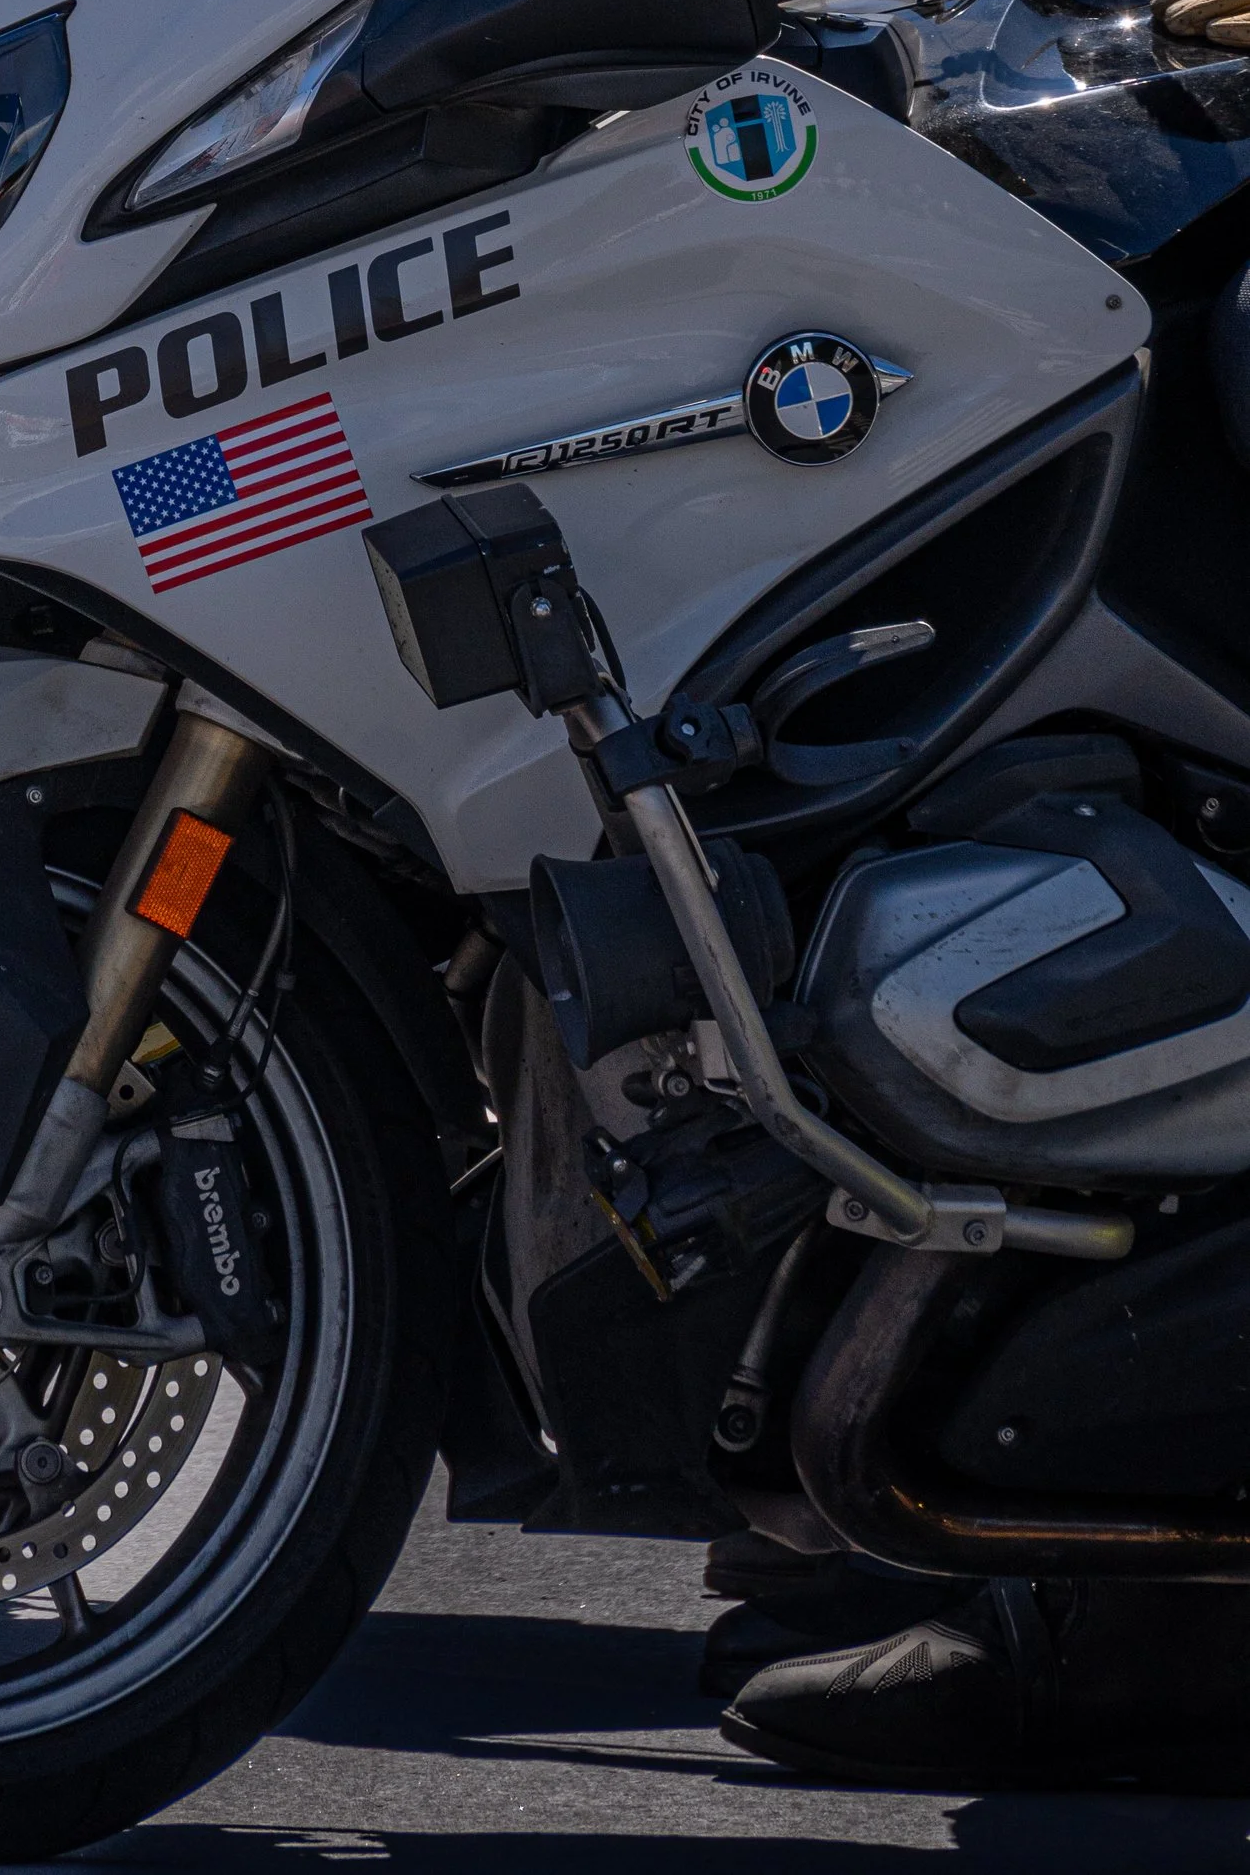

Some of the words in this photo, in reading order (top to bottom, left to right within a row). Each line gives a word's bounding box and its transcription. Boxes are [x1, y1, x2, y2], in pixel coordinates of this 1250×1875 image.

[688, 90, 711, 136] CITY
[716, 72, 743, 91] OF
[751, 71, 811, 116] IRVINE
[751, 188, 777, 201] 1971
[66, 210, 520, 458] POLICE
[757, 342, 858, 392] BMW
[194, 1166, 240, 1297] brembo
